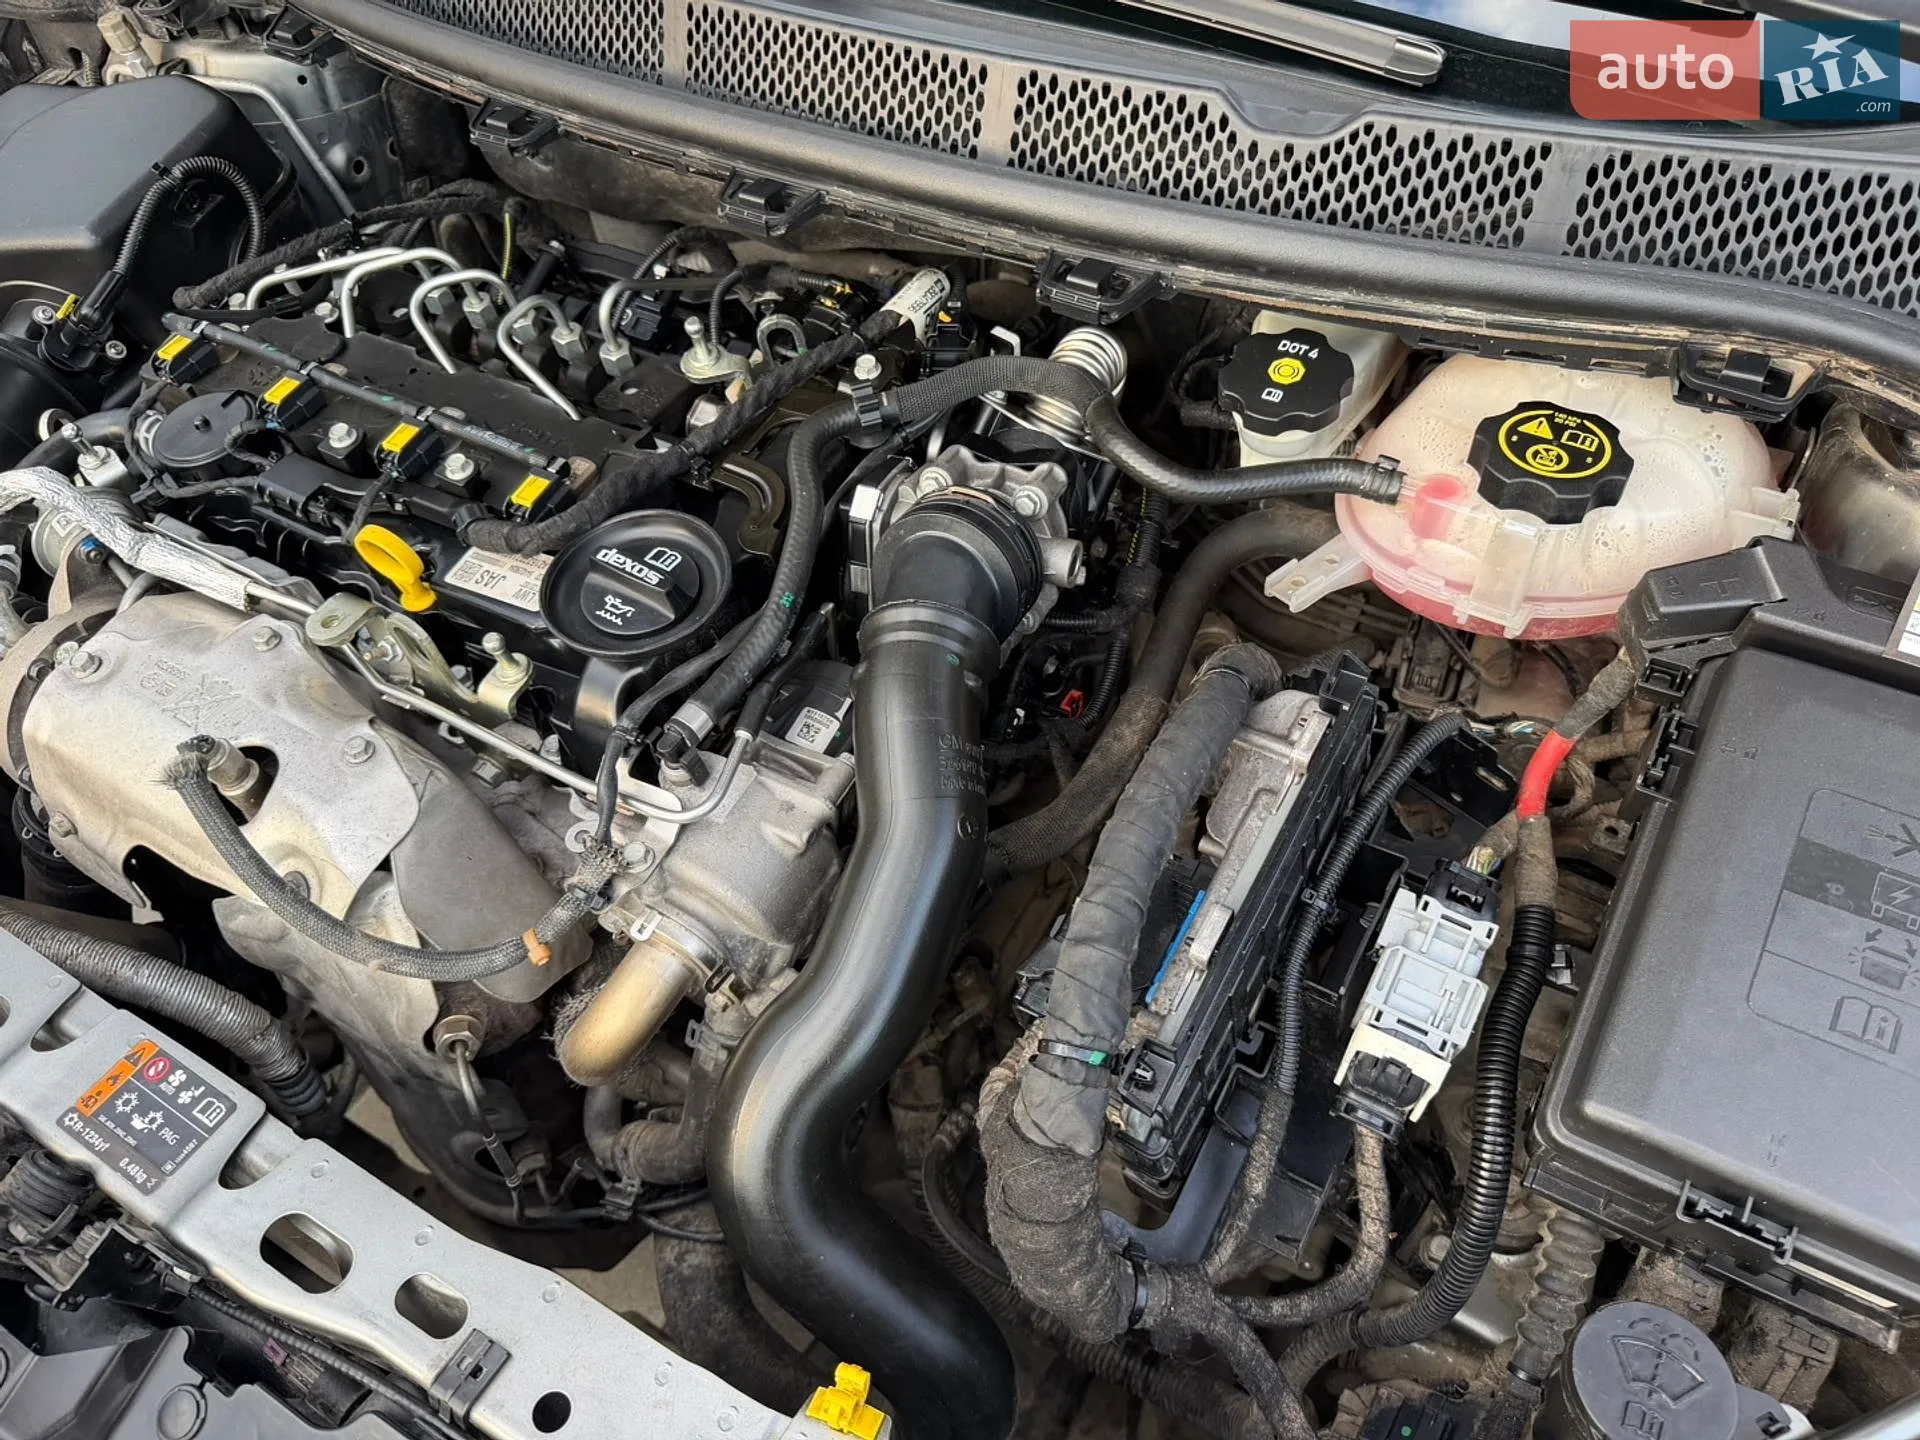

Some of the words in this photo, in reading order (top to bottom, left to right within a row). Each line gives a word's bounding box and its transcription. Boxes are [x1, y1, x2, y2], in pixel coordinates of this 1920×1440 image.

[1277, 339, 1310, 356] DOT
[1307, 348, 1320, 359] 4
[596, 548, 665, 586] dexos
[475, 569, 506, 589] JAS
[72, 1117, 111, 1153] R-1234yf
[158, 1126, 181, 1146] PAG
